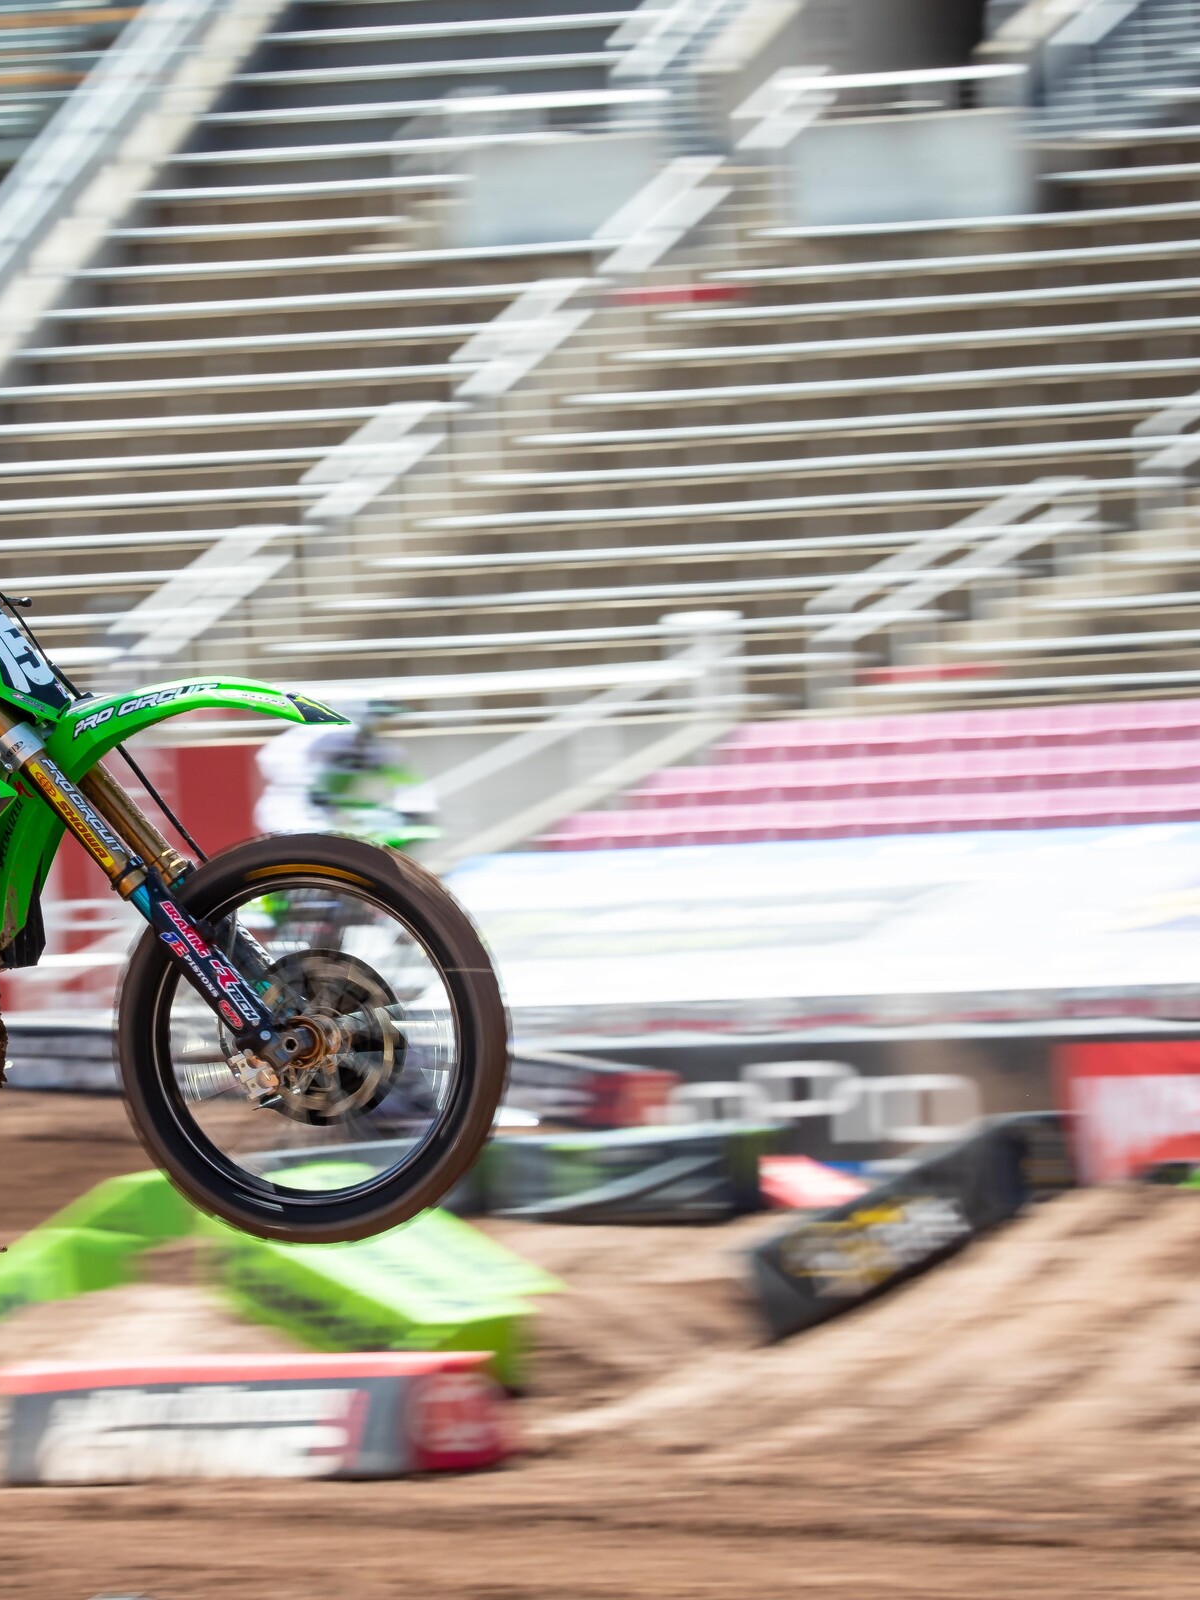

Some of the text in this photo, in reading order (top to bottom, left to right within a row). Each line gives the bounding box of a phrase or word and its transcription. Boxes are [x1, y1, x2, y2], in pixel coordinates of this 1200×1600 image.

[72, 683, 220, 740] PRO CIRCUIT
[40, 758, 74, 793] PRO
[70, 791, 126, 854] CIRCUIT
[55, 800, 108, 858] SHOWA
[159, 900, 211, 958] BRAKING
[159, 932, 190, 957] JE
[183, 954, 219, 997] PISTONS
